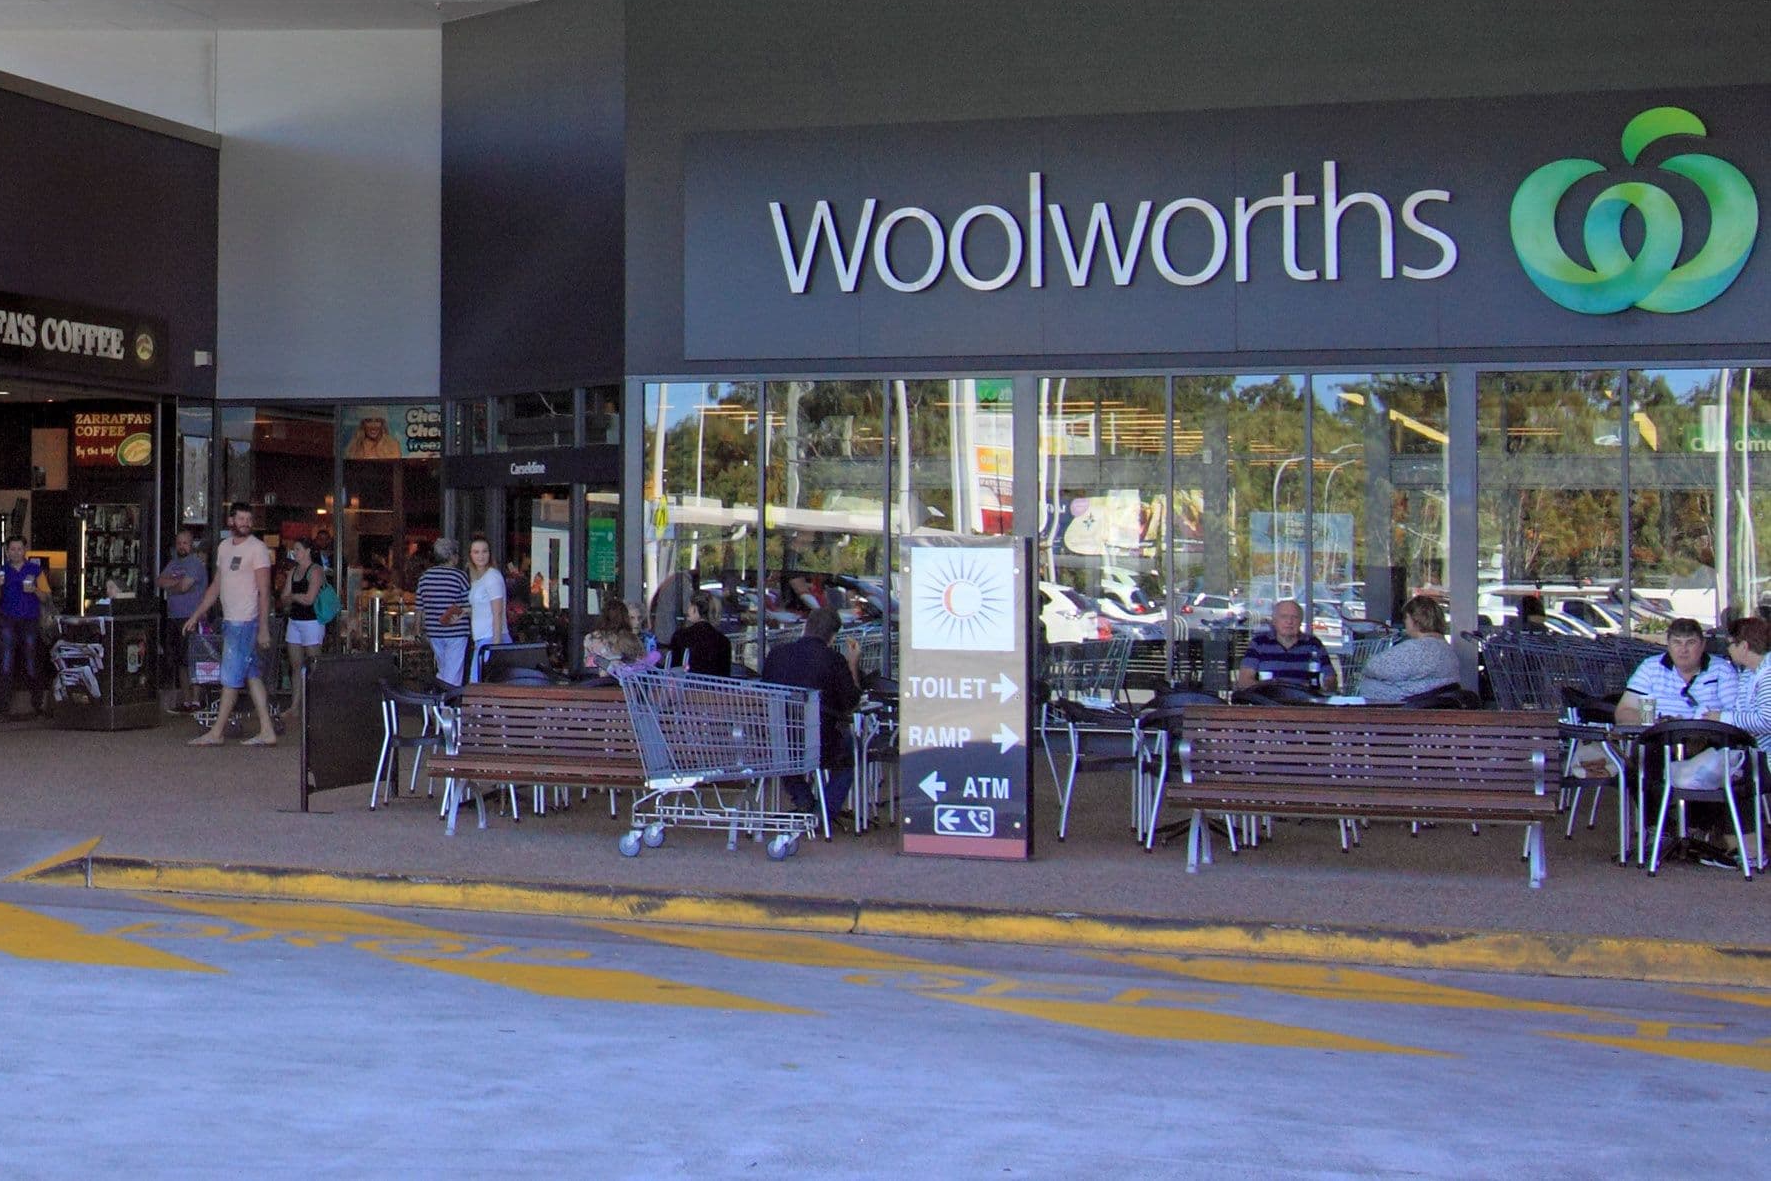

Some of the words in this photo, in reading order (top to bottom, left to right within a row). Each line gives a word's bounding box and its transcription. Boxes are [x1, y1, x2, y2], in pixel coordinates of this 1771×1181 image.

[769, 160, 1459, 294] Woolworths
[41, 317, 125, 359] COFFEE
[74, 413, 152, 425] ZARRAFFA'S
[74, 425, 126, 437] COFFEE
[908, 675, 987, 700] TOILET
[908, 725, 972, 749] RAMP
[963, 776, 1010, 800] ATM
